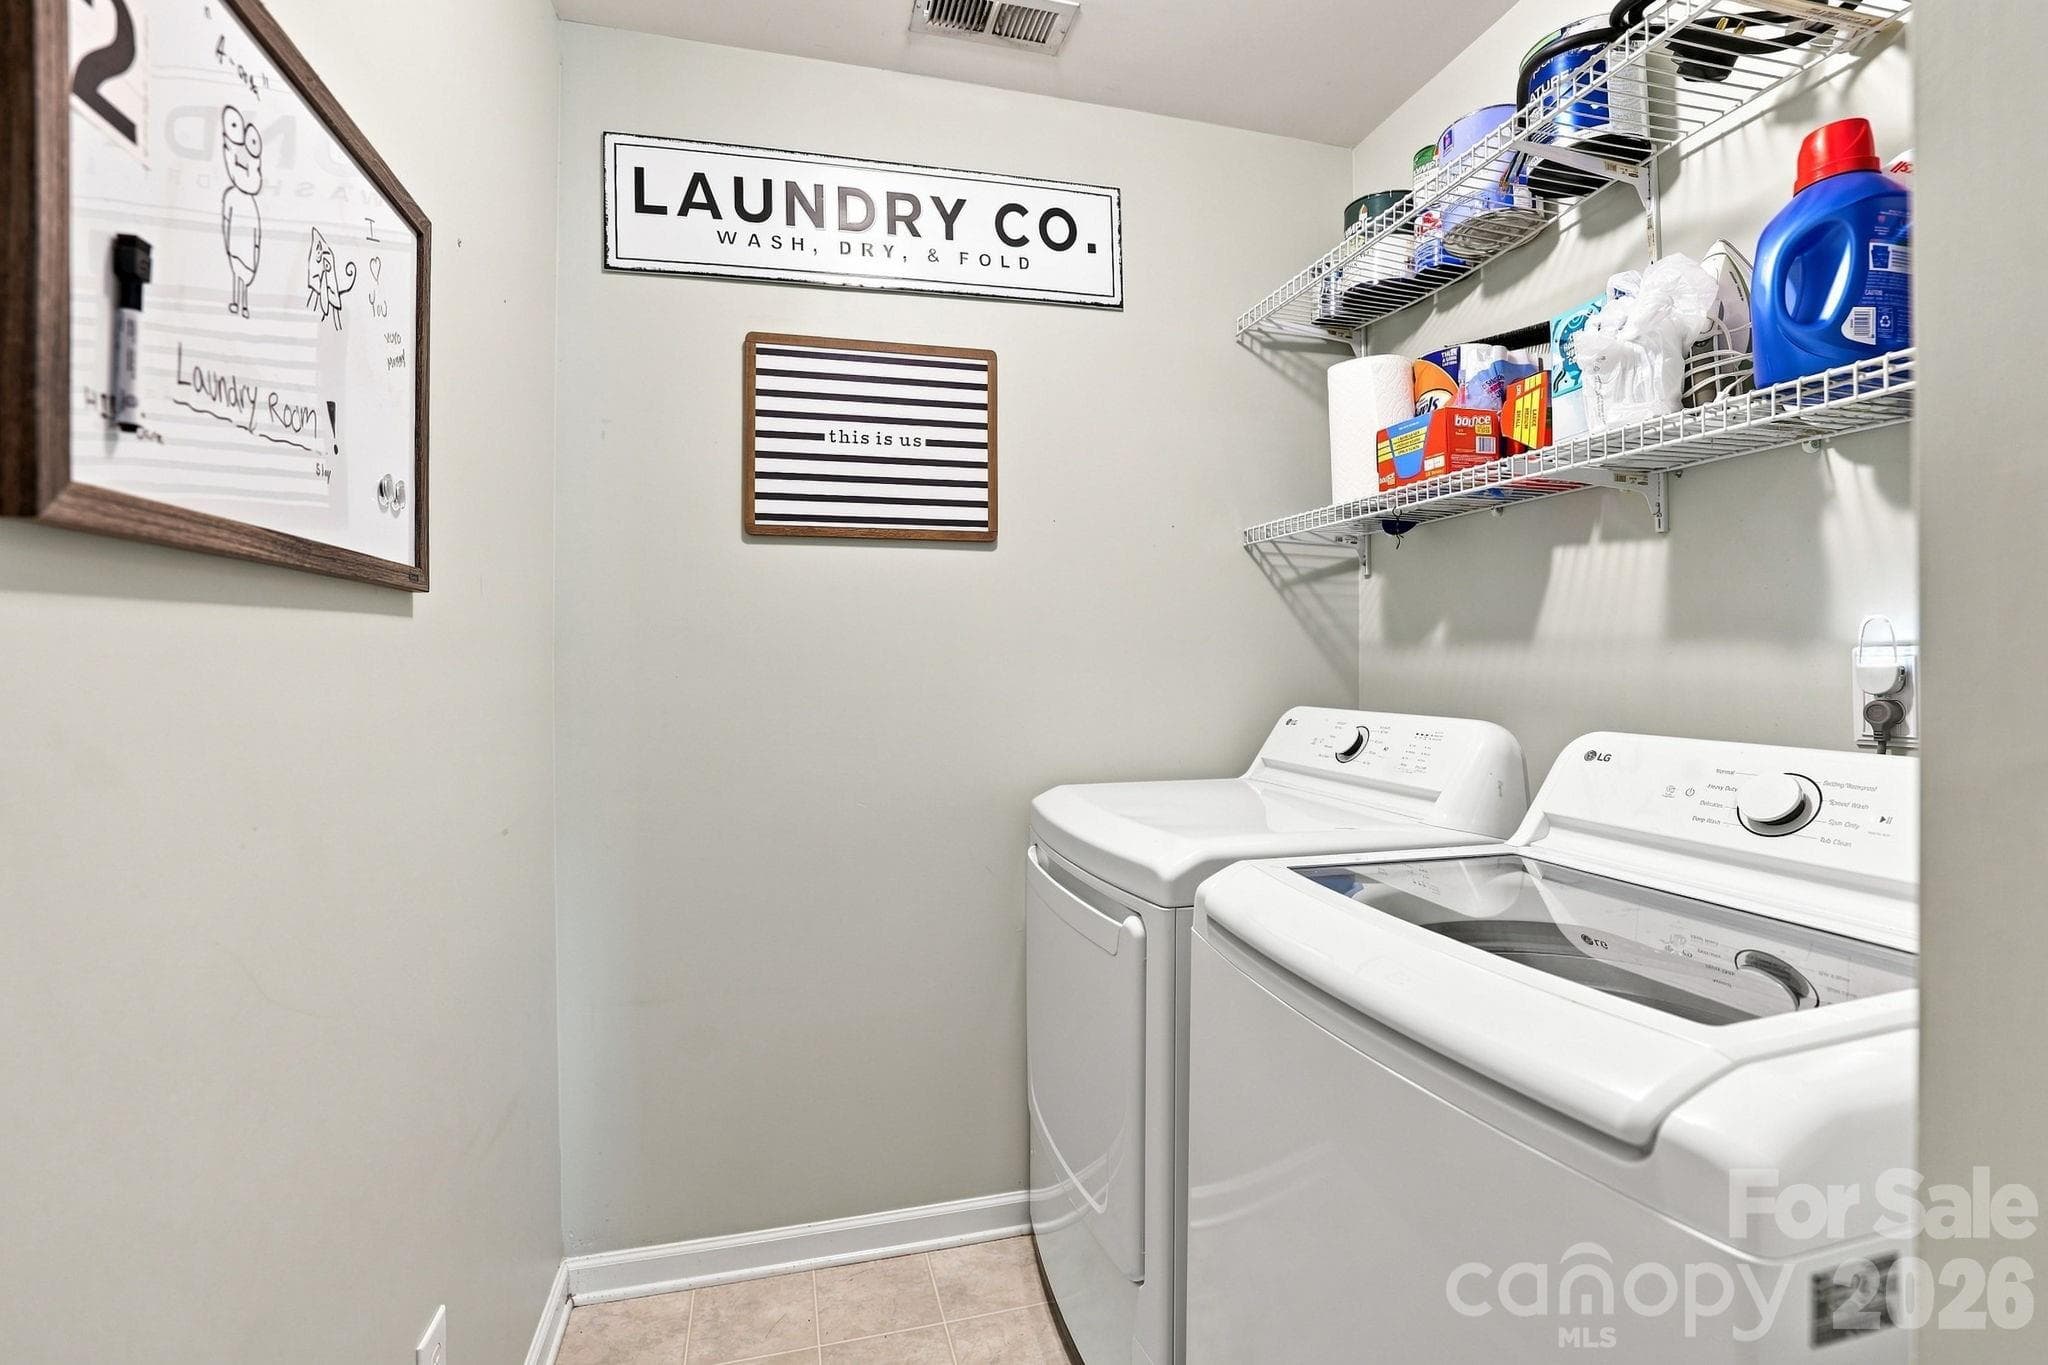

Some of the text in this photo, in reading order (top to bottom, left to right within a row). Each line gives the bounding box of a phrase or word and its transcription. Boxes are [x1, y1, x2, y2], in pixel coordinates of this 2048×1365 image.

[633, 166, 1097, 253] LAUNDRY CO.
[717, 229, 1032, 270] WASH, DRY, & FOLD
[177, 342, 258, 434] Laundry
[1454, 414, 1492, 427] bounce
[829, 429, 922, 448] this is us
[1597, 753, 1612, 762] LG
